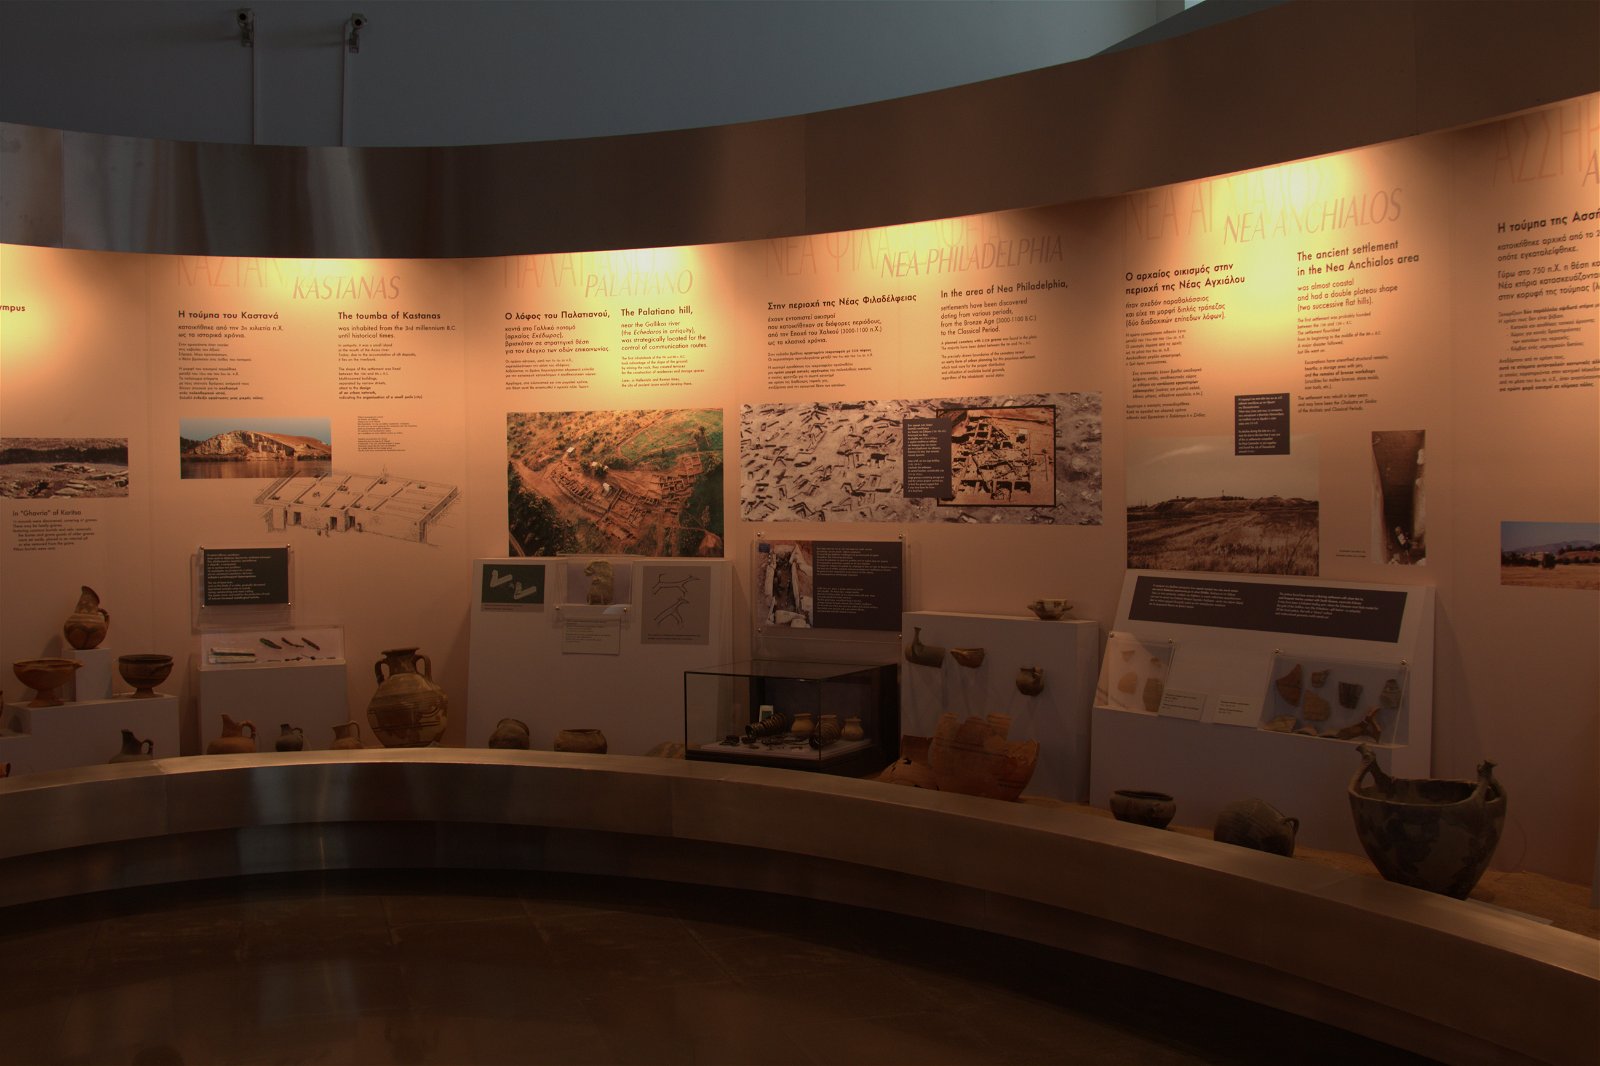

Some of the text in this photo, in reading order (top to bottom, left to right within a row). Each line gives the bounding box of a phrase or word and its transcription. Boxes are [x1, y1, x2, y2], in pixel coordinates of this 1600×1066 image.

[1224, 211, 1266, 245] NEA
[1273, 187, 1402, 237] ANCHIALOS
[1498, 223, 1506, 233] Η
[1510, 220, 1547, 231] τούμπα
[1550, 217, 1567, 226] της
[881, 235, 1064, 278] NEA PHILADELPHIA
[1297, 240, 1399, 261] The ancient settlement
[1125, 272, 1133, 281] Ο
[1136, 270, 1170, 281] αρχαίος
[1174, 265, 1210, 276] οικισμός
[1298, 256, 1419, 276] in the Nea Anchialos area
[292, 275, 401, 300] KASTANAS
[585, 269, 693, 298] PALATIANO
[951, 289, 962, 297] the
[986, 285, 994, 294] of
[997, 285, 1013, 293] Nea
[1016, 280, 1068, 292] Philadelphia,
[1125, 283, 1159, 295] περιοχή
[1179, 280, 1201, 289] Νέας
[1205, 276, 1245, 288] Αγχιάλου
[1332, 279, 1354, 288] coastal
[1330, 289, 1352, 299] double
[1354, 288, 1377, 297] plateau
[788, 299, 820, 310] περιοχή
[839, 297, 859, 306] Νέας
[862, 294, 916, 304] Φιλαδέλφειας
[999, 297, 1028, 306] discovered
[1298, 298, 1373, 312] (two successive flat hills).
[178, 310, 185, 319] Η
[189, 311, 220, 321] τούμπα
[391, 311, 399, 320] of
[516, 312, 541, 322] λόφος
[638, 308, 675, 316] Palatiano
[679, 306, 693, 315] hill,
[941, 313, 957, 321] dating
[954, 319, 962, 328] the
[984, 317, 994, 327] Age
[634, 336, 665, 344] strategically
